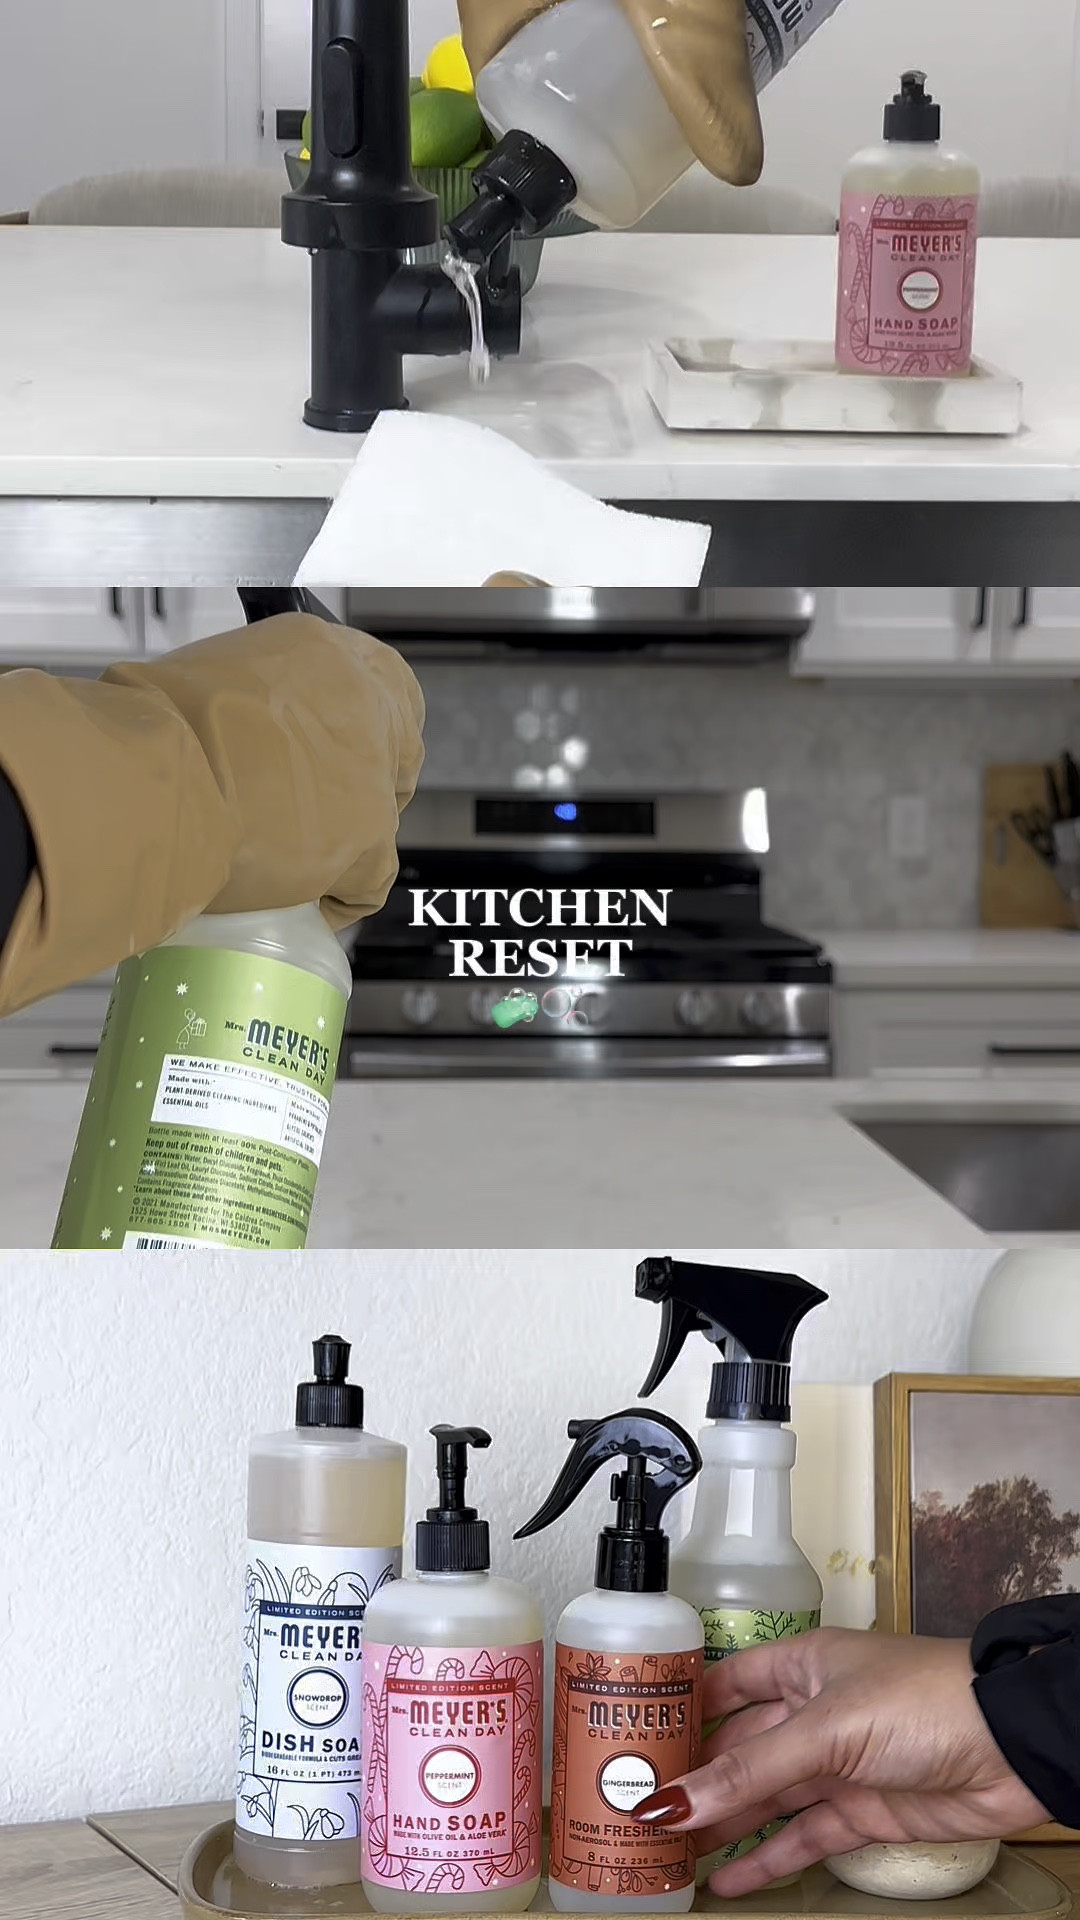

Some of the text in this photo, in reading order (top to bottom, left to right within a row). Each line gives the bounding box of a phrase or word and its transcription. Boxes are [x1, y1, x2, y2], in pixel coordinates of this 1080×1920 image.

[891, 234, 961, 252] MEYER'S
[891, 254, 935, 262] CLEAN
[875, 317, 958, 330] HAND SOAP
[225, 1018, 329, 1071] Mrs. MEYER'S
[171, 1059, 186, 1067] WE
[189, 1061, 220, 1071] MAKE
[243, 1047, 325, 1086] CLEAN DAY
[168, 1074, 189, 1083] Made
[162, 1097, 193, 1108] ESSENTIAL
[171, 1129, 192, 1138] made
[146, 1137, 164, 1149] Keep
[166, 1140, 179, 1149] out
[180, 1140, 189, 1150] of
[190, 1143, 213, 1154] reach
[215, 1147, 224, 1156] of
[225, 1149, 254, 1163] children
[255, 1157, 268, 1168] and
[160, 1199, 208, 1214] Manufactured
[266, 1606, 301, 1615] LIMITED
[305, 1608, 345, 1616] EDITION
[263, 1628, 279, 1637] Mrs.
[280, 1650, 337, 1661] CLEAN
[391, 1682, 509, 1692] LIMITED EDITION SCENT
[572, 1681, 689, 1693] LIMITED EDITION SCENT
[294, 1694, 342, 1702] SNOWDROP
[392, 1699, 508, 1726] Mrs. MEYER'S
[572, 1701, 687, 1729] Mrs. MEYER'S
[410, 1727, 506, 1737] CLEAN DAY
[588, 1728, 685, 1741] CLEAN DAY
[262, 1730, 360, 1752] DISH SOA
[267, 1765, 278, 1775] 16
[426, 1772, 475, 1780] PEPPERMINT
[602, 1779, 654, 1788] GINGERBREAD
[393, 1812, 506, 1831] HAND SOAP
[569, 1820, 599, 1834] ROOM
[467, 1832, 487, 1840] ALOE
[569, 1833, 611, 1846] NON-AEROSOL
[404, 1846, 430, 1857] 12.5
[587, 1852, 595, 1861] 8
[614, 1857, 626, 1865] OZ
